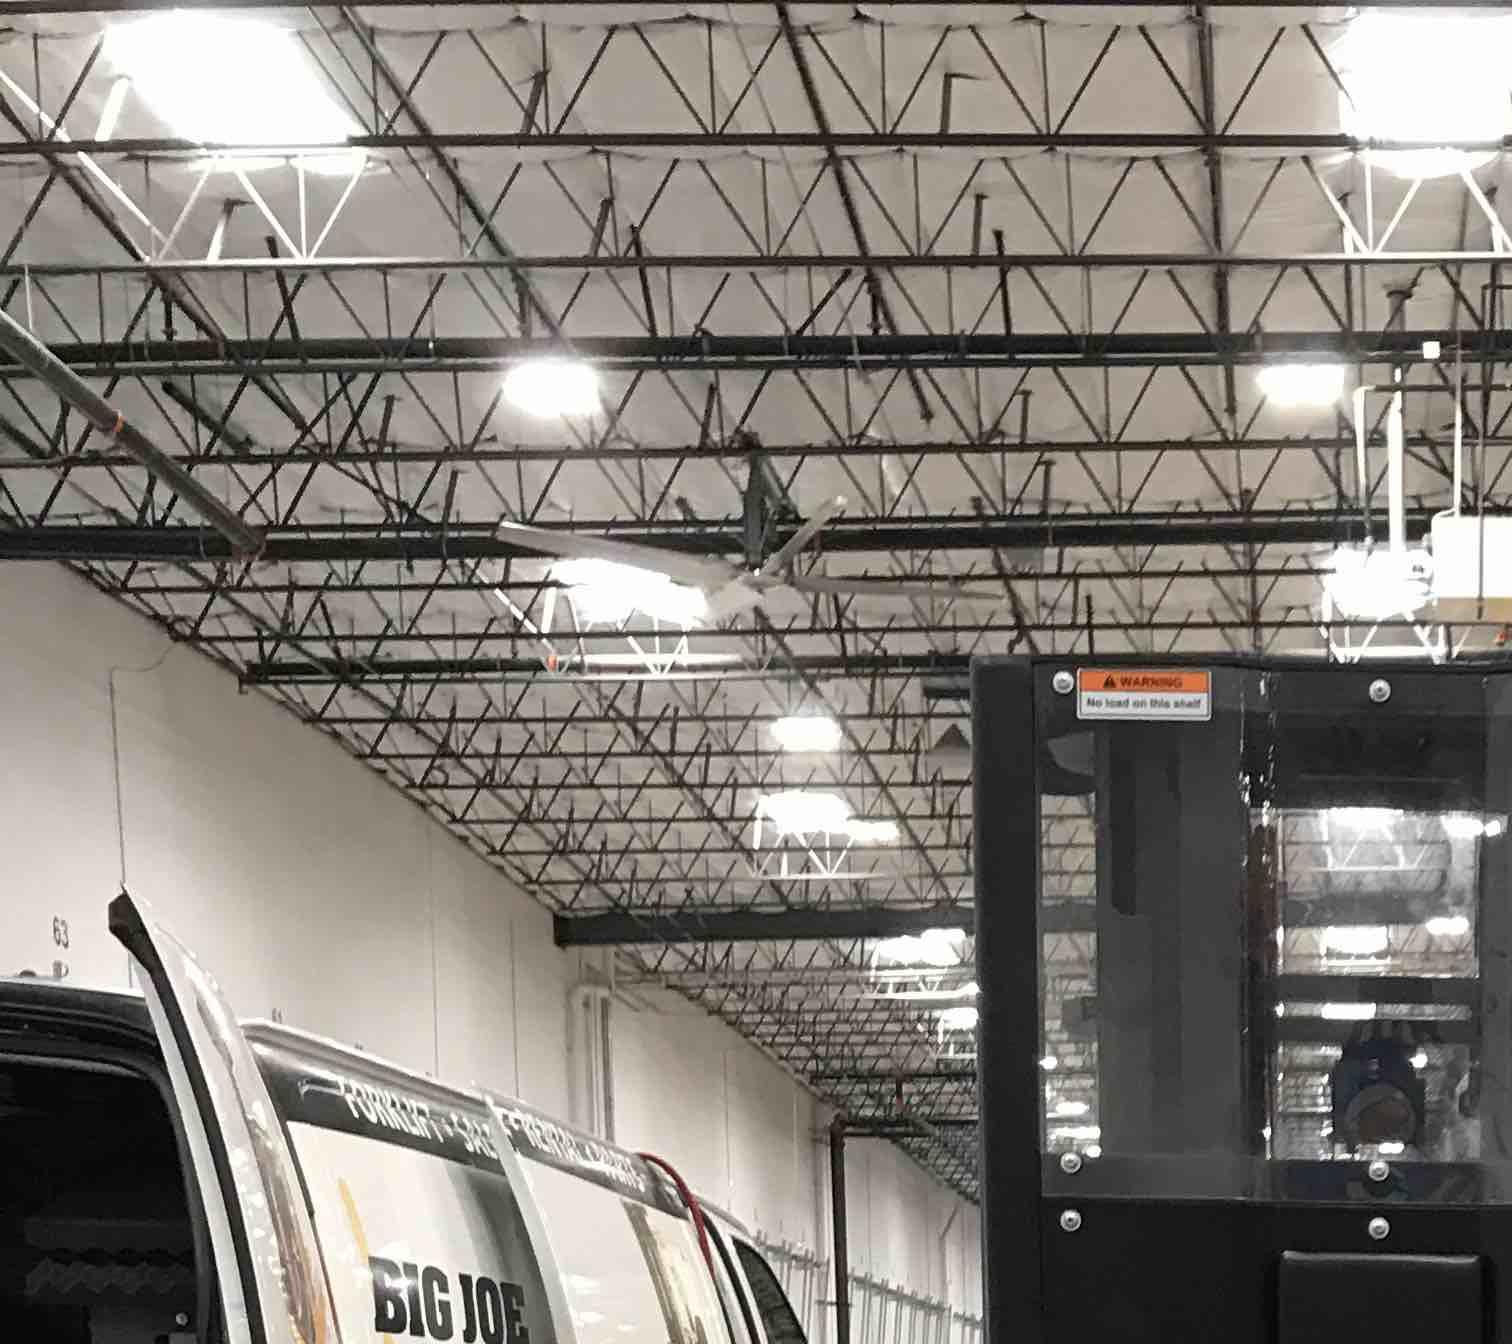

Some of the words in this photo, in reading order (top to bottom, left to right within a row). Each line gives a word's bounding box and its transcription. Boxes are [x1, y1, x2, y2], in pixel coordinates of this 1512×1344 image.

[1120, 677, 1183, 689] WARNING
[1087, 698, 1103, 708] No
[1105, 698, 1130, 708] load
[1132, 700, 1147, 708] on
[1150, 698, 1171, 708] this
[1173, 698, 1201, 709] shelf
[338, 1078, 443, 1143] FORKLIFT
[368, 1256, 453, 1341] BIG
